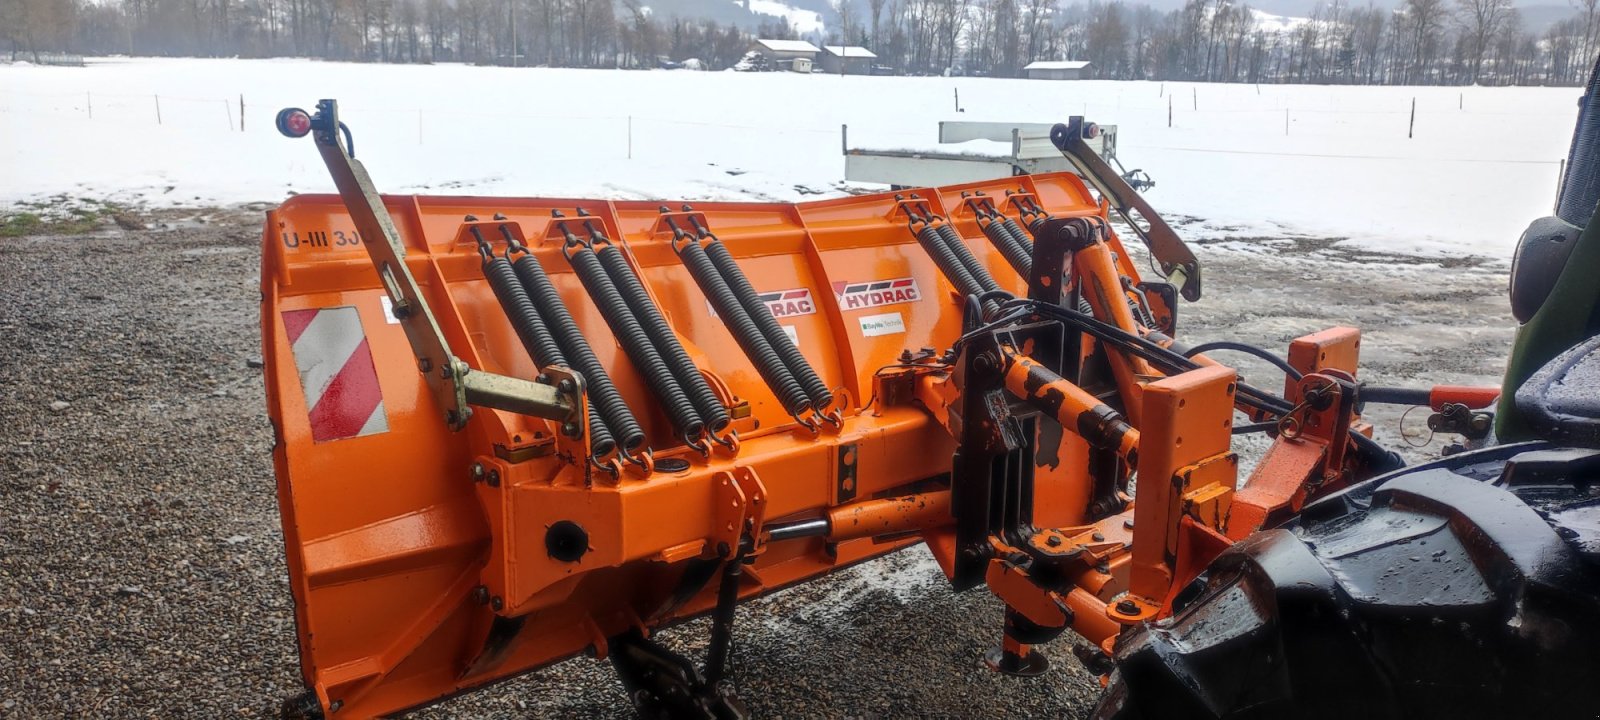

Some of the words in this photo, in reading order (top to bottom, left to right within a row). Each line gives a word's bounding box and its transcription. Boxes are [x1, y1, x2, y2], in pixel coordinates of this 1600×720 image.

[283, 231, 328, 248] U-III
[846, 288, 918, 308] HYDRAC
[769, 300, 811, 316] RAC
